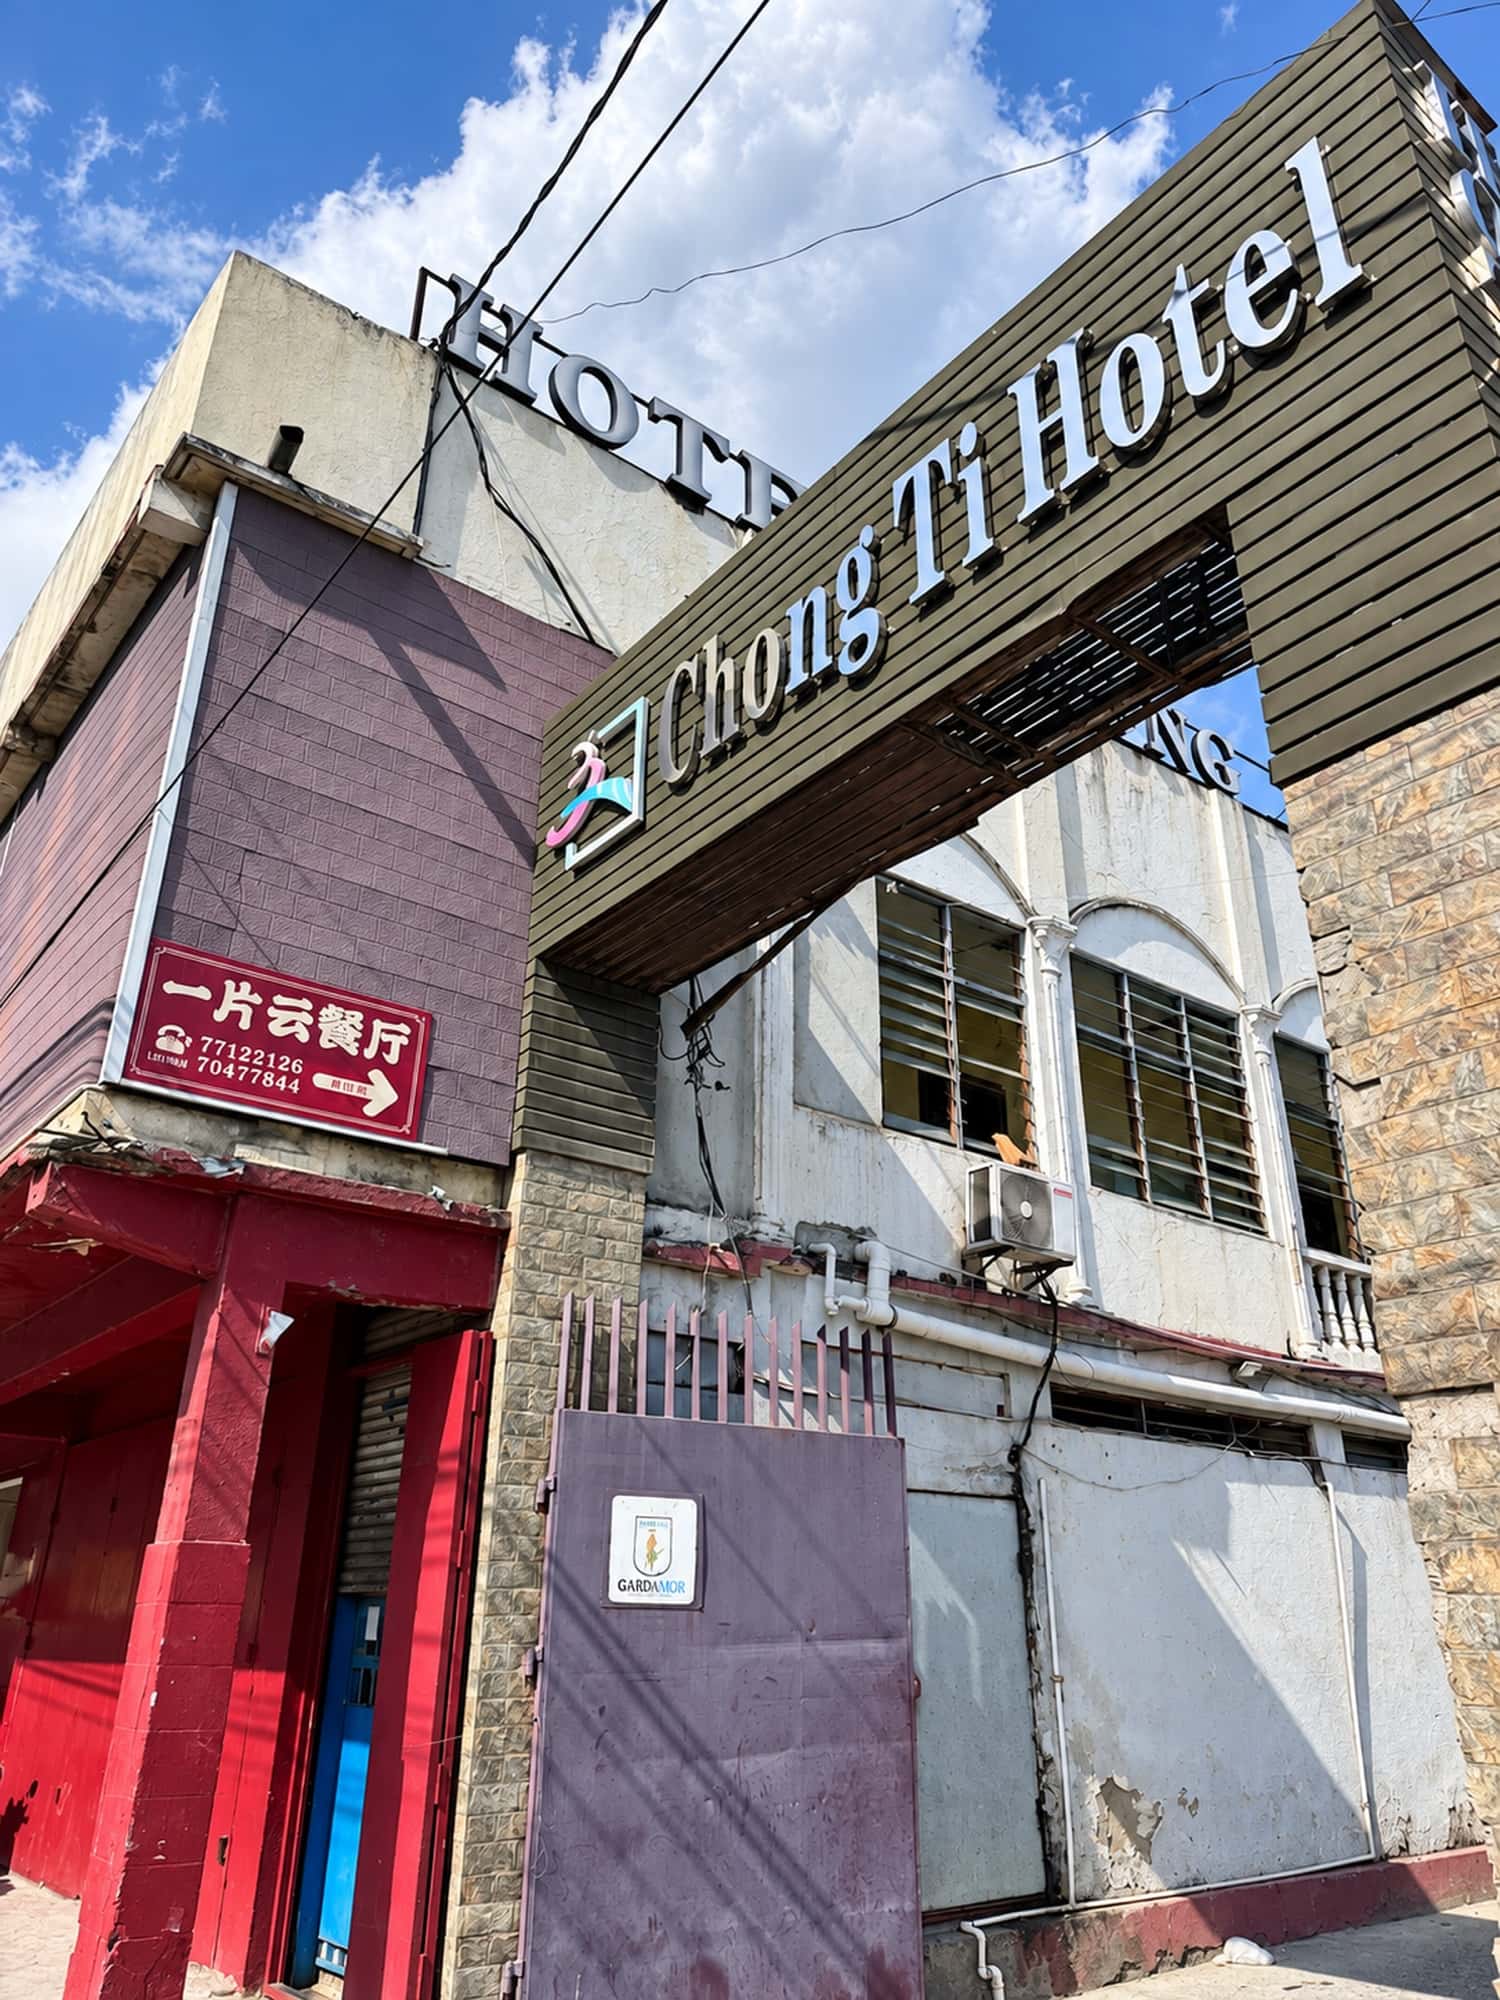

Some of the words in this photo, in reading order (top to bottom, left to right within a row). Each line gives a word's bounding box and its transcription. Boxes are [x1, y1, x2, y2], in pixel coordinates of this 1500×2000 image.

[1007, 136, 1370, 527] Hotel
[162, 979, 412, 1065] 一片云餐厅
[197, 1056, 301, 1094] 70477844
[200, 1036, 304, 1075] 77122126
[617, 1578, 686, 1594] GARDAMOR
